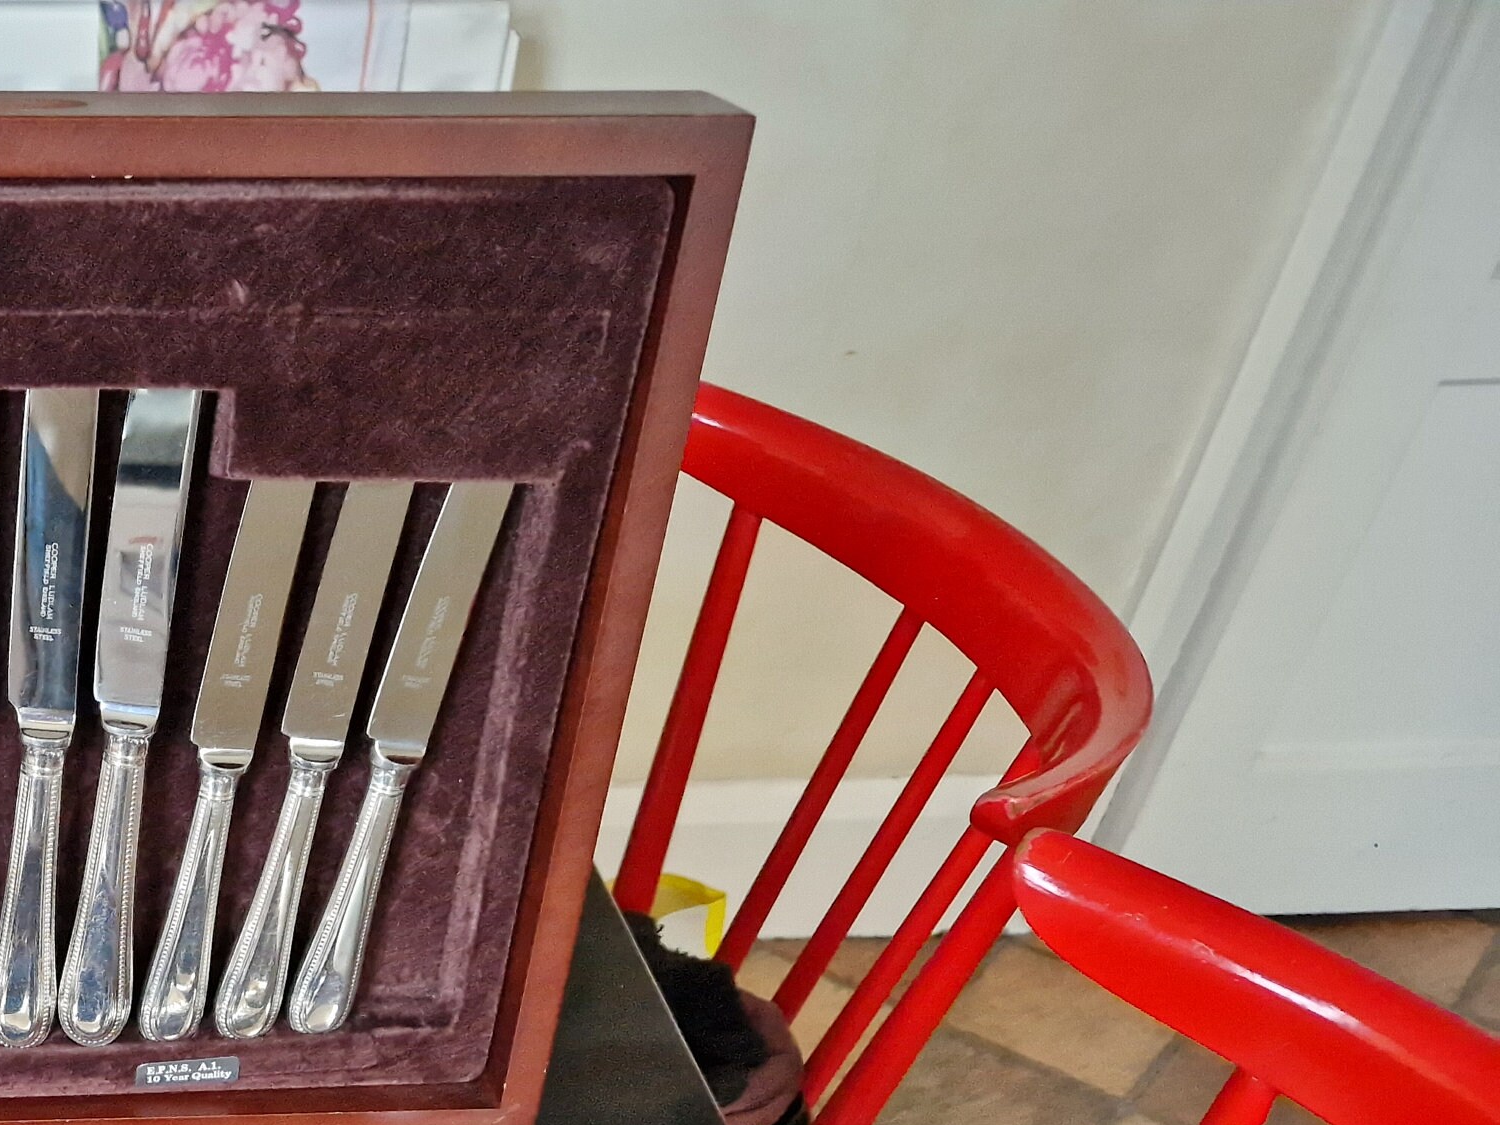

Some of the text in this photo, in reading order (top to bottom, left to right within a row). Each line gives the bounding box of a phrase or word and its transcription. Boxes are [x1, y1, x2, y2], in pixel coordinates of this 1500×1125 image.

[46, 543, 58, 620] COOPER LUDLAM
[137, 543, 153, 621] COOPER LUDLAM
[124, 634, 144, 642] STEEL
[146, 1061, 222, 1076] E.P.N.S. A.1.
[146, 1070, 232, 1084] 10 Year Quality
